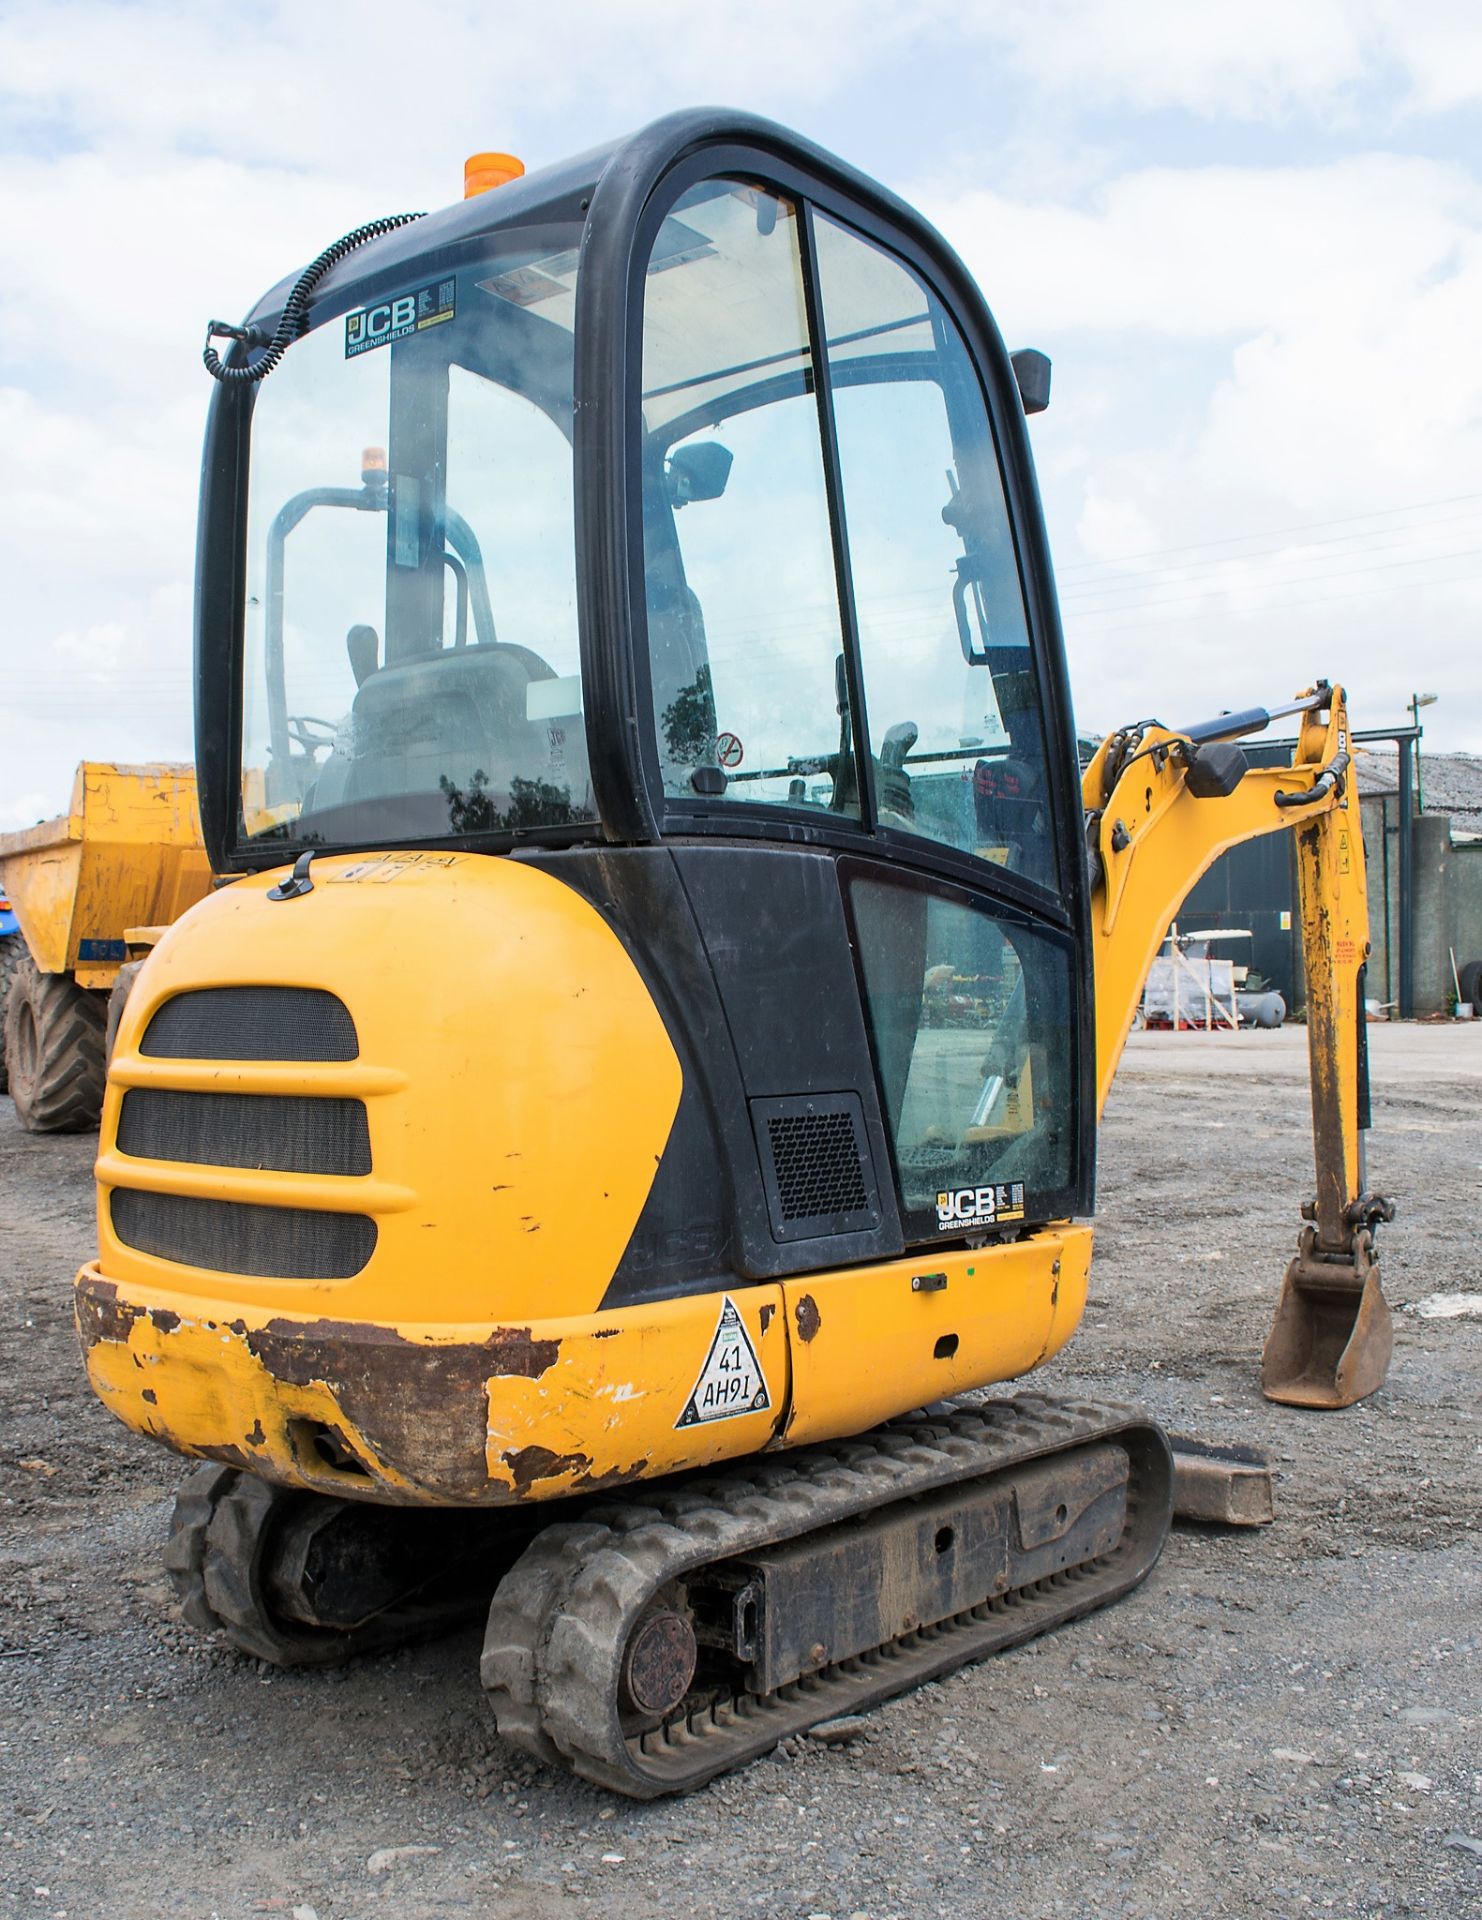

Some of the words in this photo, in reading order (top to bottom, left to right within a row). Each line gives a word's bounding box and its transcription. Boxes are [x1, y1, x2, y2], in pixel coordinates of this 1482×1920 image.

[348, 296, 416, 345] JCB
[348, 324, 415, 355] GREENSHIELDS
[937, 1187, 995, 1221] JCB
[939, 1214, 995, 1231] GREENSHIELDS
[719, 1345, 742, 1373] 41
